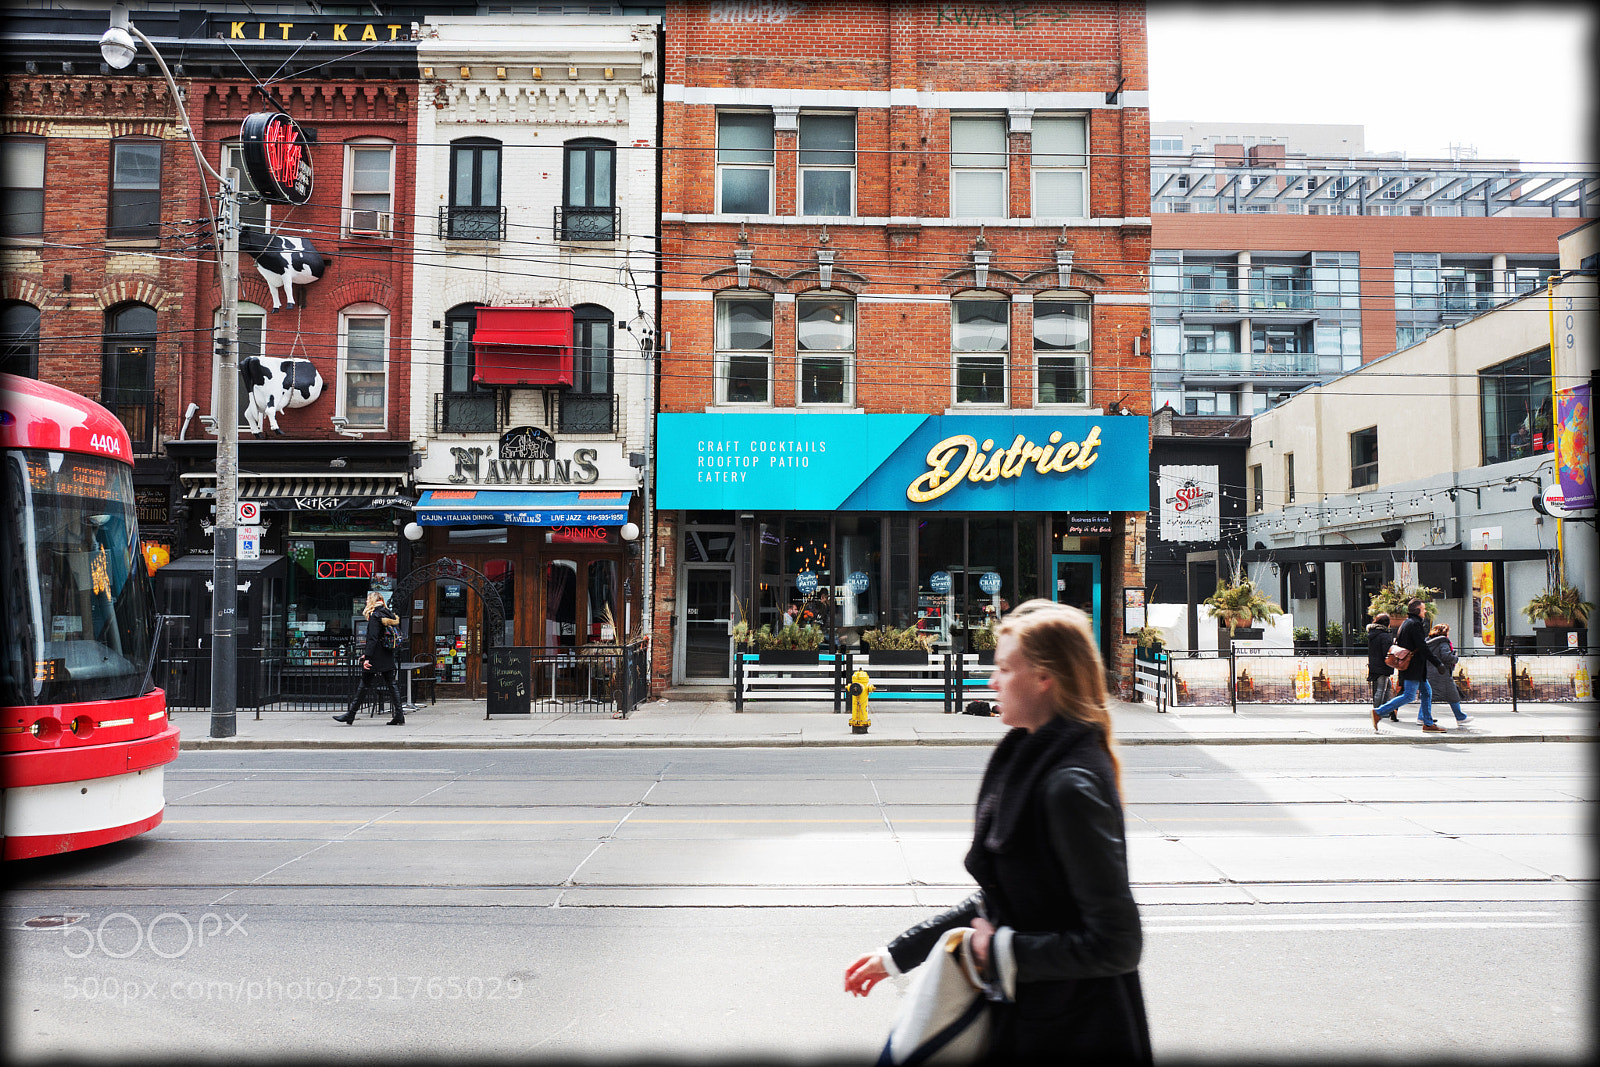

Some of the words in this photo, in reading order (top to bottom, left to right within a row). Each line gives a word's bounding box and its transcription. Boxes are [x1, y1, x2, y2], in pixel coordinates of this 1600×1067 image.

[231, 22, 294, 40] KIT
[333, 24, 402, 41] KAT
[1565, 297, 1574, 349] 309
[90, 433, 120, 454] 4404
[698, 441, 740, 452] CRAFT
[750, 441, 826, 452] COCKTAILS
[448, 445, 599, 484] N'AWLINS
[698, 456, 760, 467] ROOFTOP
[770, 456, 809, 467] PATIO
[906, 425, 1102, 503] District
[698, 471, 747, 482] EATERY
[564, 526, 607, 539] DINING
[317, 561, 373, 578] OPEN
[1482, 605, 1494, 626] SOL
